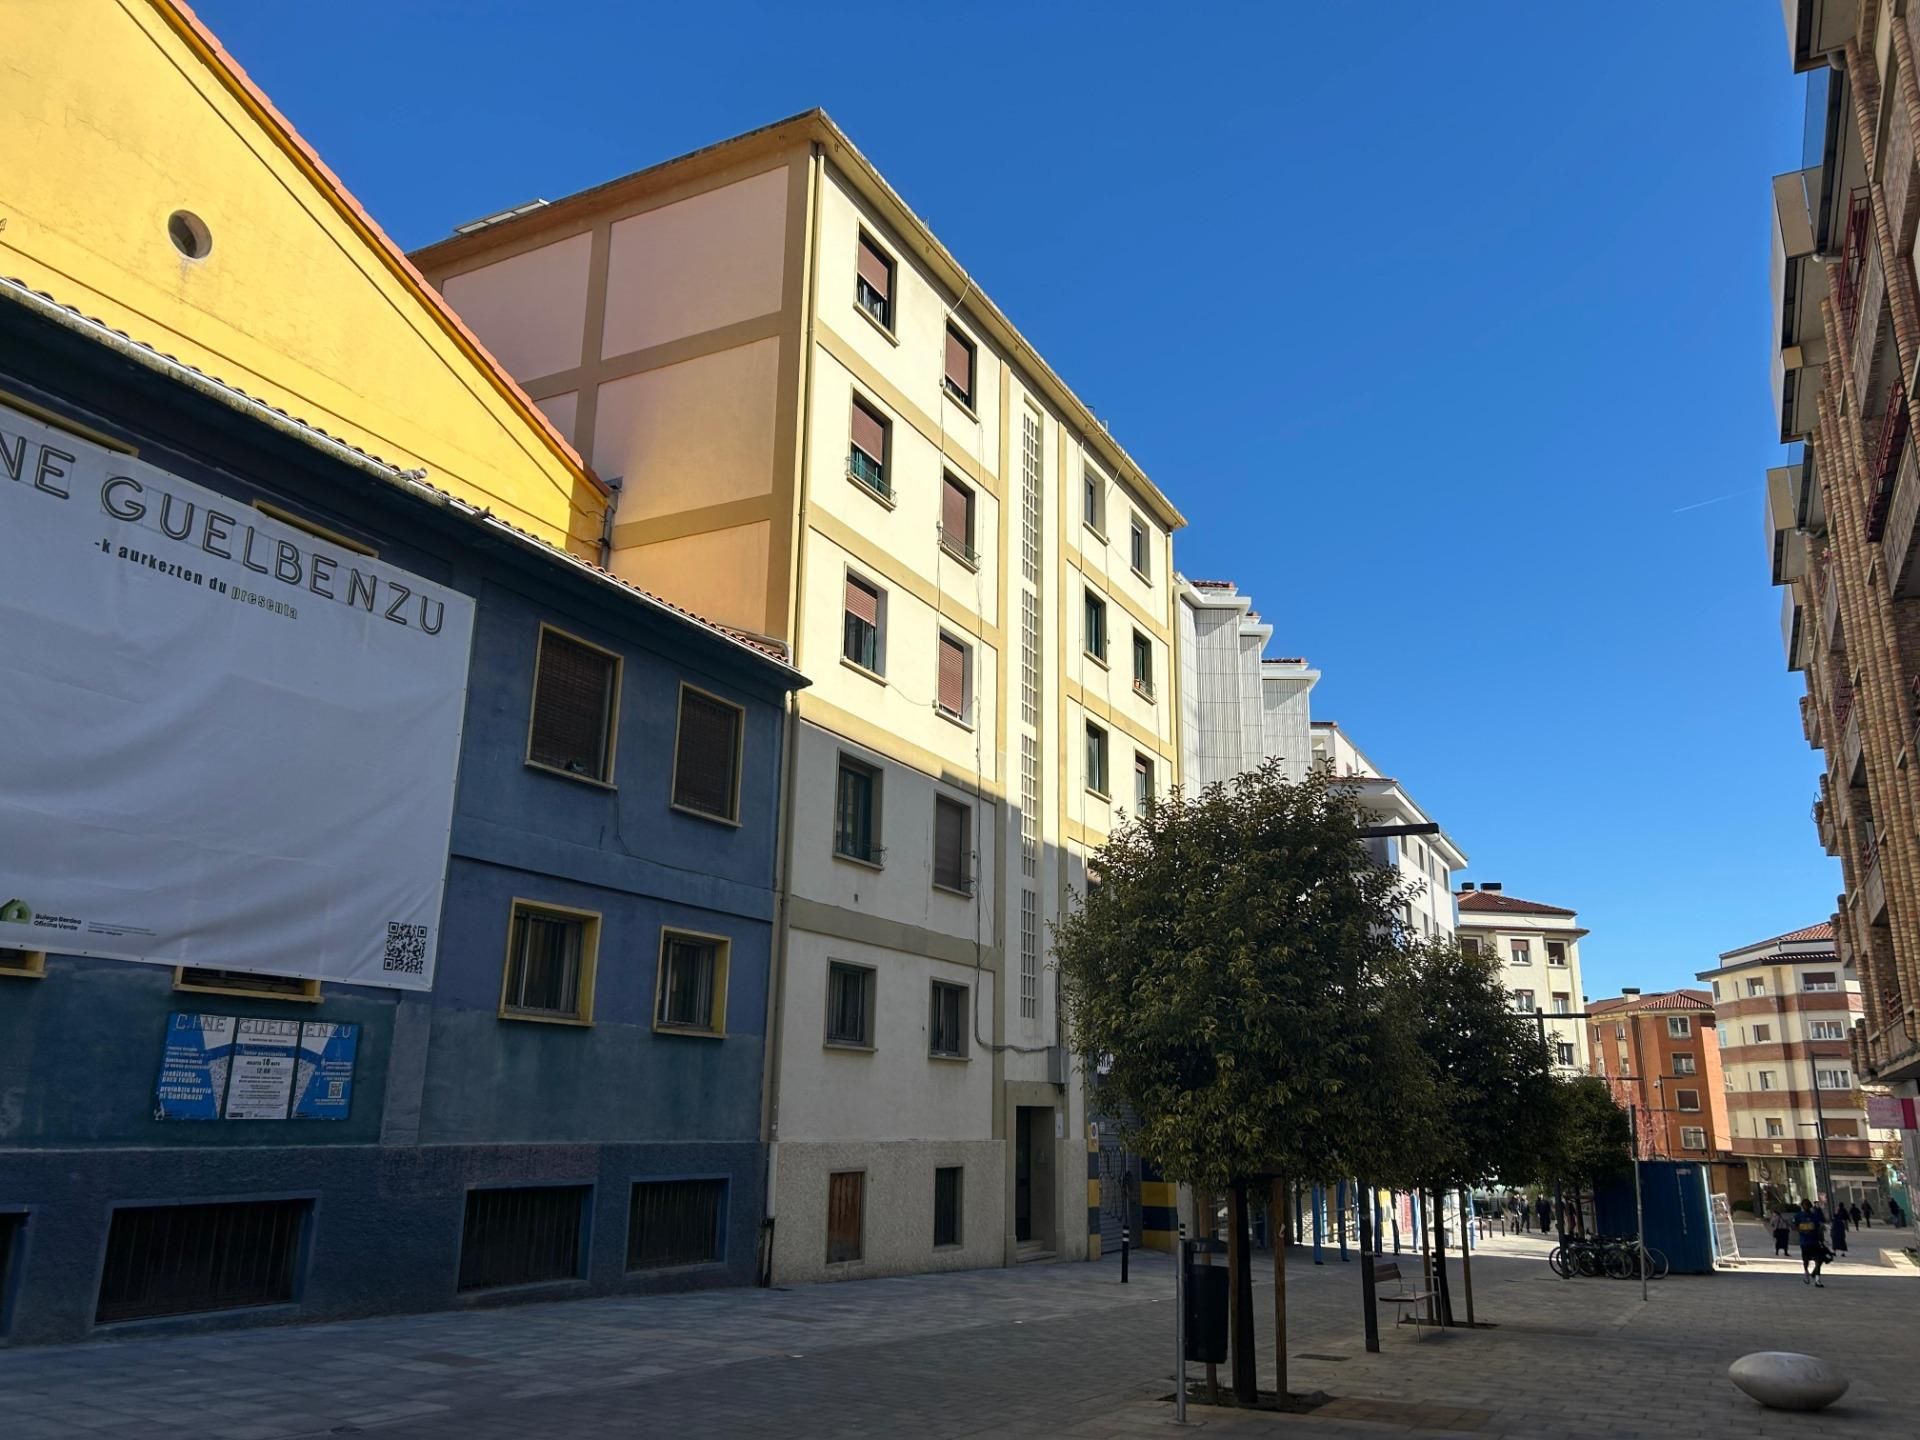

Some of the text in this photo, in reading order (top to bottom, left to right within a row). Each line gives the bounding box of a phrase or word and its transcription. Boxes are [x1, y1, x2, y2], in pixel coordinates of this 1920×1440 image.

[101, 475, 445, 635] GUELBENZU
[118, 545, 203, 586] aurkezten
[209, 576, 228, 595] du
[231, 586, 298, 620] presenta
